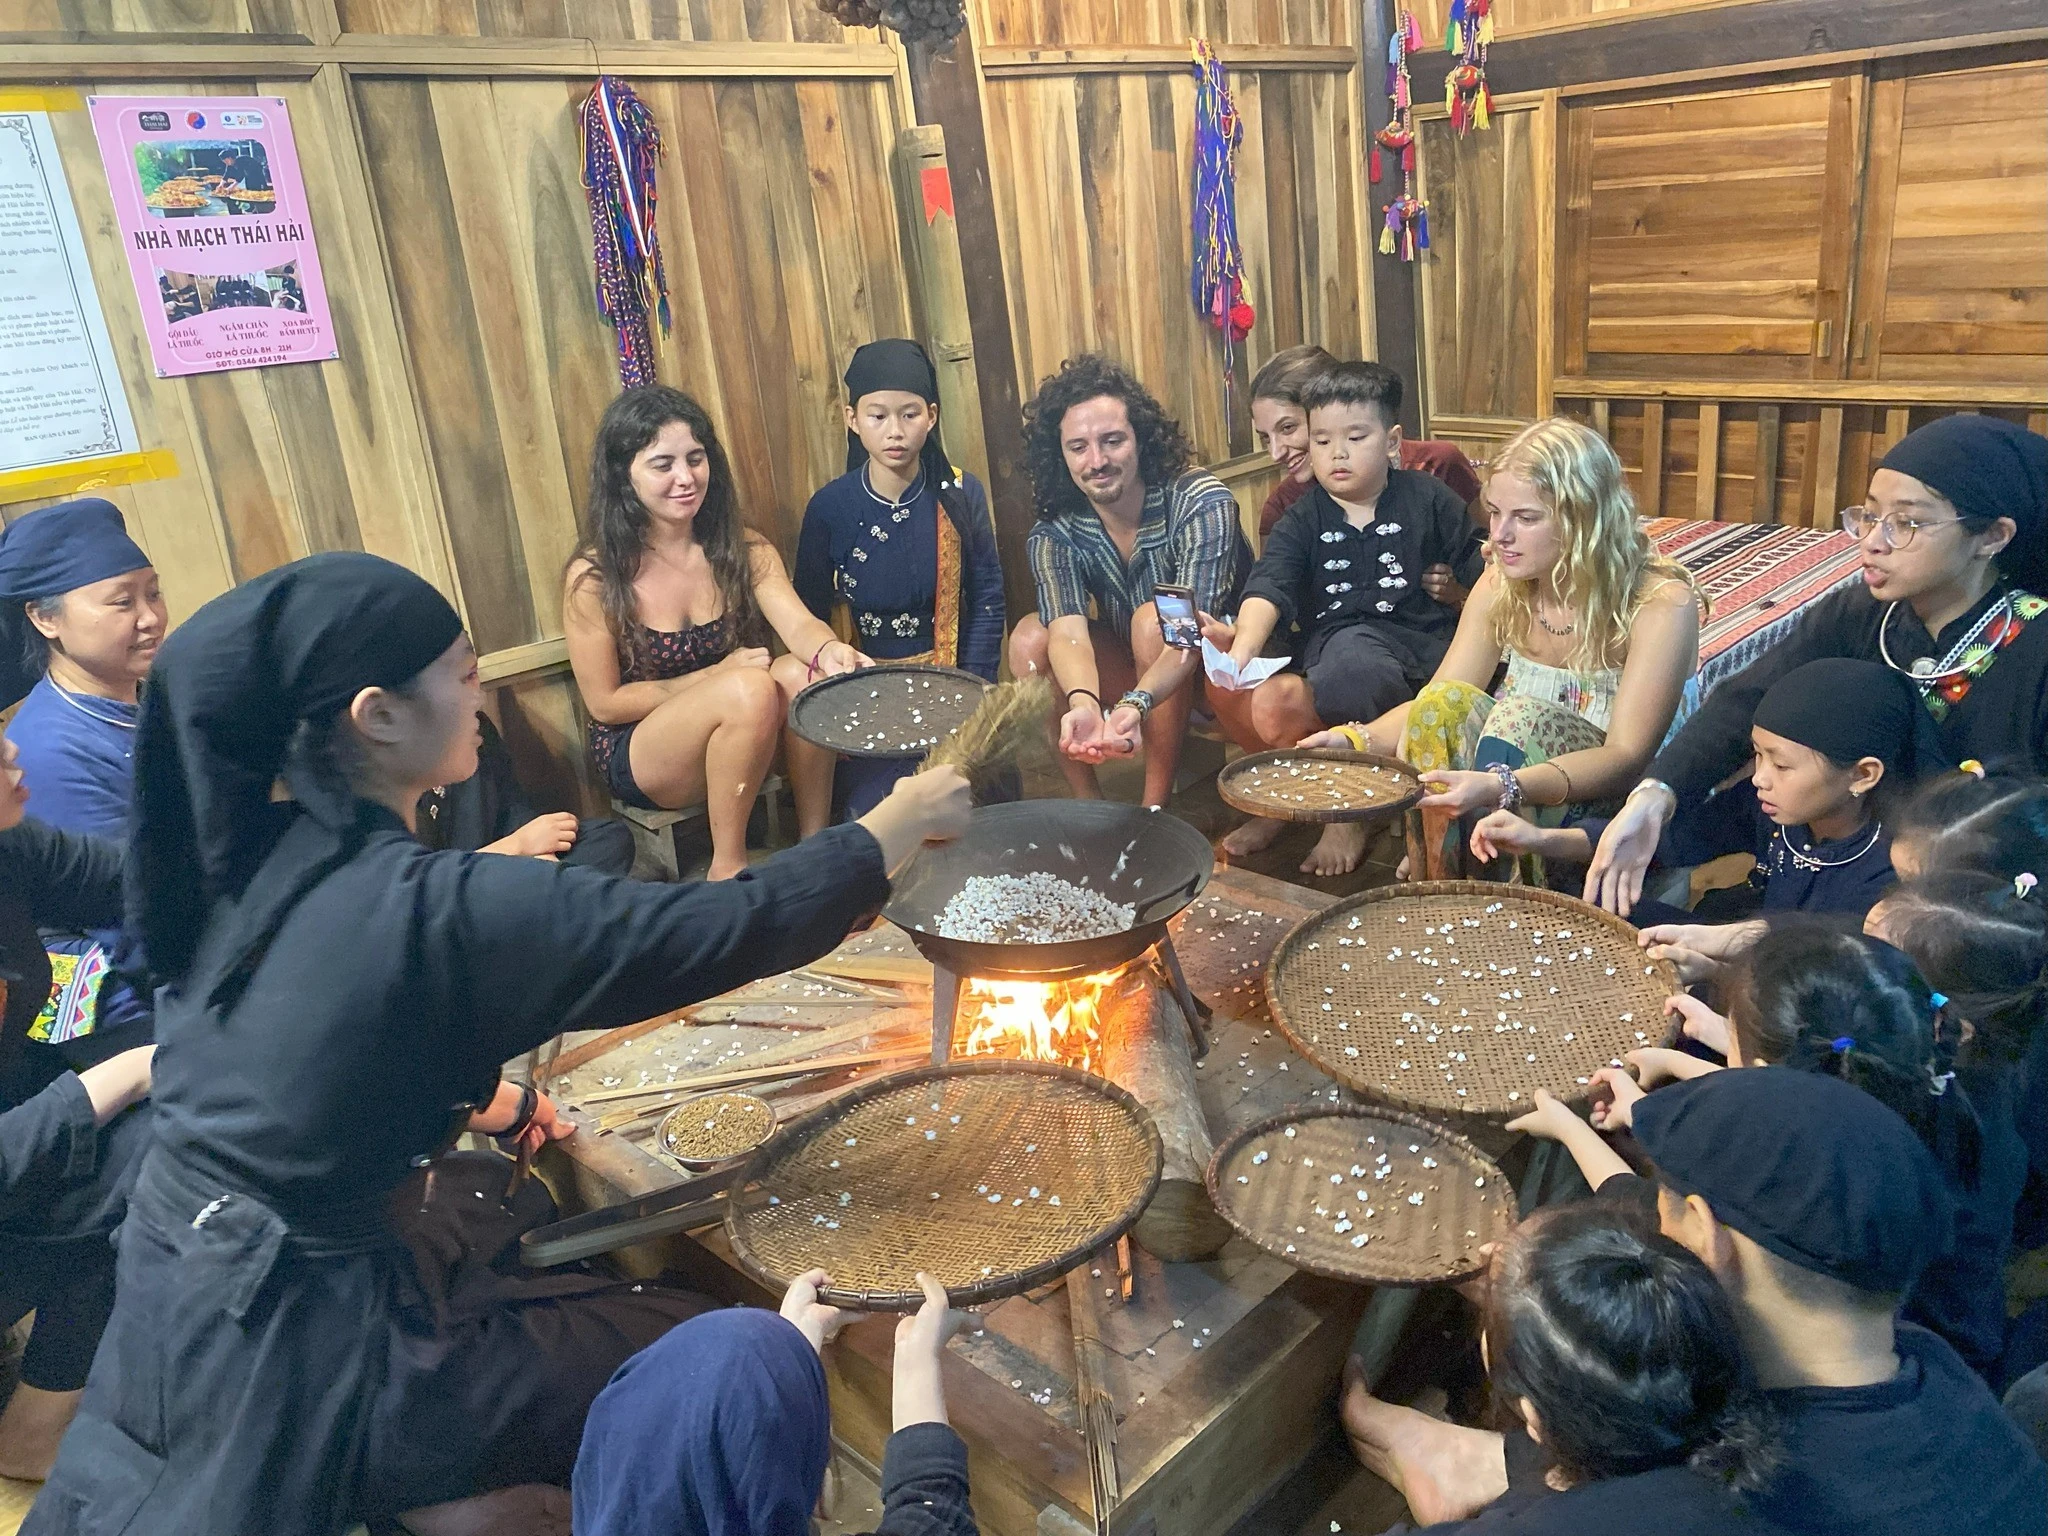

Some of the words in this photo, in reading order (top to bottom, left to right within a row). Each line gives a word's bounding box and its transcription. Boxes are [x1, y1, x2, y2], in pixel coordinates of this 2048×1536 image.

[134, 224, 173, 249] NHÀ
[177, 227, 227, 252] MẠCH
[231, 220, 272, 244] THÁI
[276, 218, 305, 242] HẢI
[220, 322, 244, 332] NGÂM
[246, 320, 268, 329] CHÂN
[300, 318, 314, 326] BÓP
[168, 330, 182, 340] GỘI
[183, 328, 198, 337] ĐẦU
[226, 332, 237, 341] LÁ
[239, 329, 268, 340] THUỐC
[280, 328, 295, 336] BẤM
[297, 326, 320, 335] HUYỆT
[168, 340, 177, 349] LÁ
[178, 337, 204, 348] THUỐC
[206, 350, 222, 358] GIỜ
[225, 347, 238, 357] MỞ
[240, 346, 259, 355] CỬA
[216, 360, 235, 368] SĐT:
[236, 357, 256, 365] 0346
[273, 354, 287, 362] 194
